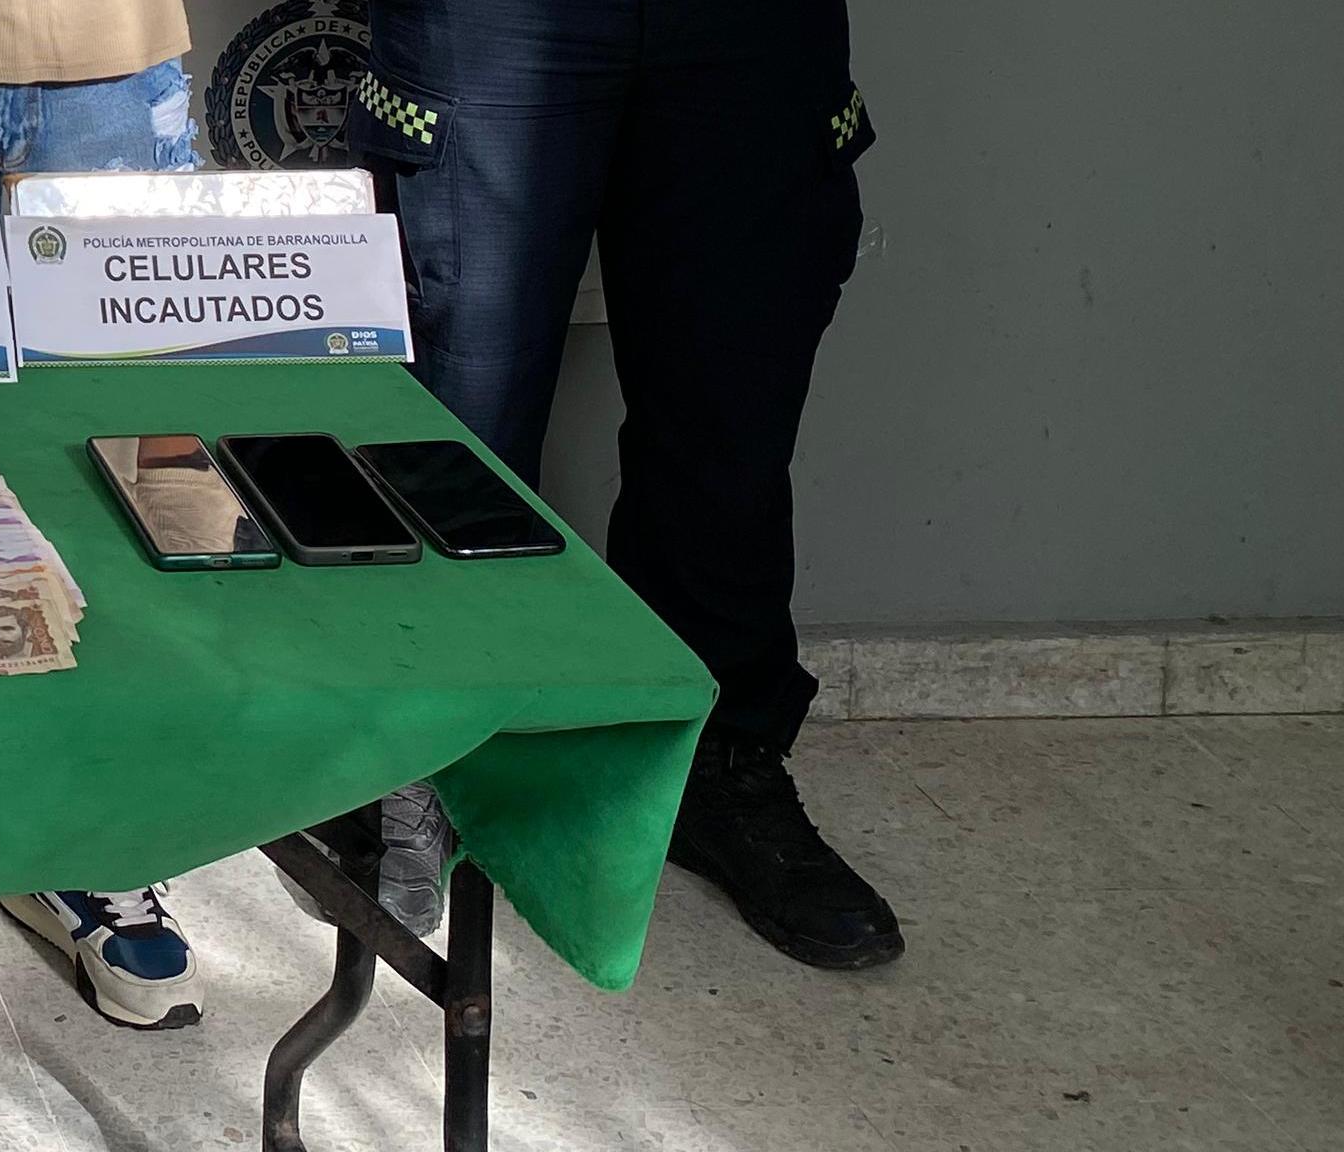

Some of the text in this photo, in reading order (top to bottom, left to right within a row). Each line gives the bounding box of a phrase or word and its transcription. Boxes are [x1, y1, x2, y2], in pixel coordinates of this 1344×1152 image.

[315, 20, 339, 33] DE
[83, 234, 368, 248] POLICÍA METROPOLITANA DE BARRANQUILLA
[104, 252, 311, 282] CELULARES
[99, 294, 324, 324] INCAUTADOS
